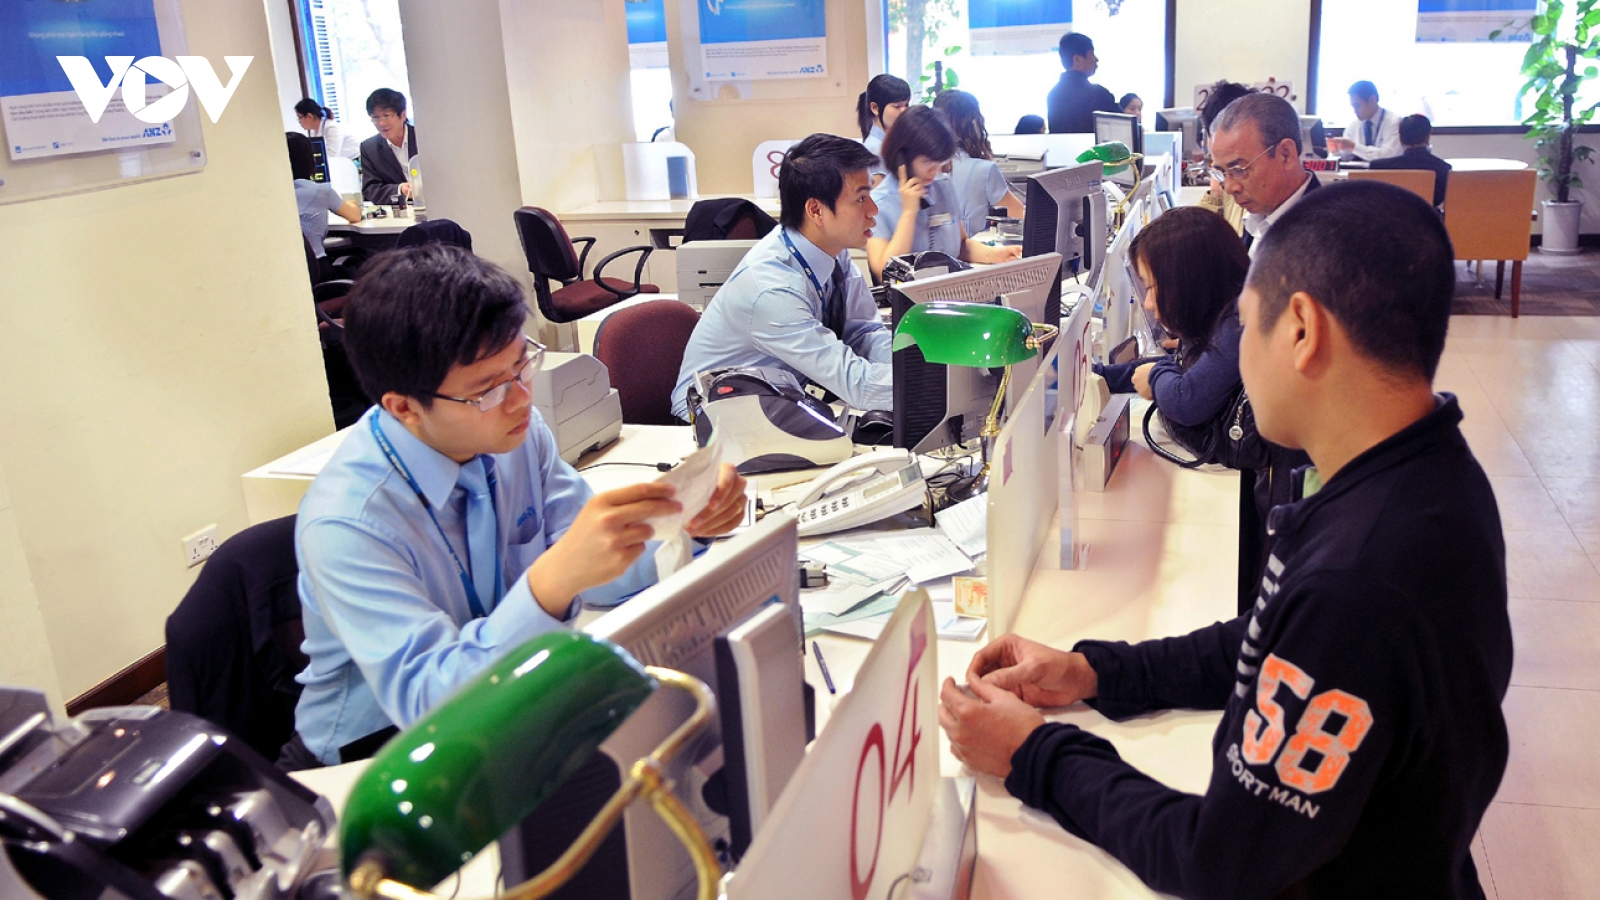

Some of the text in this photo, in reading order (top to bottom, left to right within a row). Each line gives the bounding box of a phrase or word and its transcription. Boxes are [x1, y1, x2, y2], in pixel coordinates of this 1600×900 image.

[143, 127, 162, 138] ANZ
[1242, 653, 1374, 795] 58
[850, 670, 921, 900] 04
[1268, 786, 1320, 818] MAN
